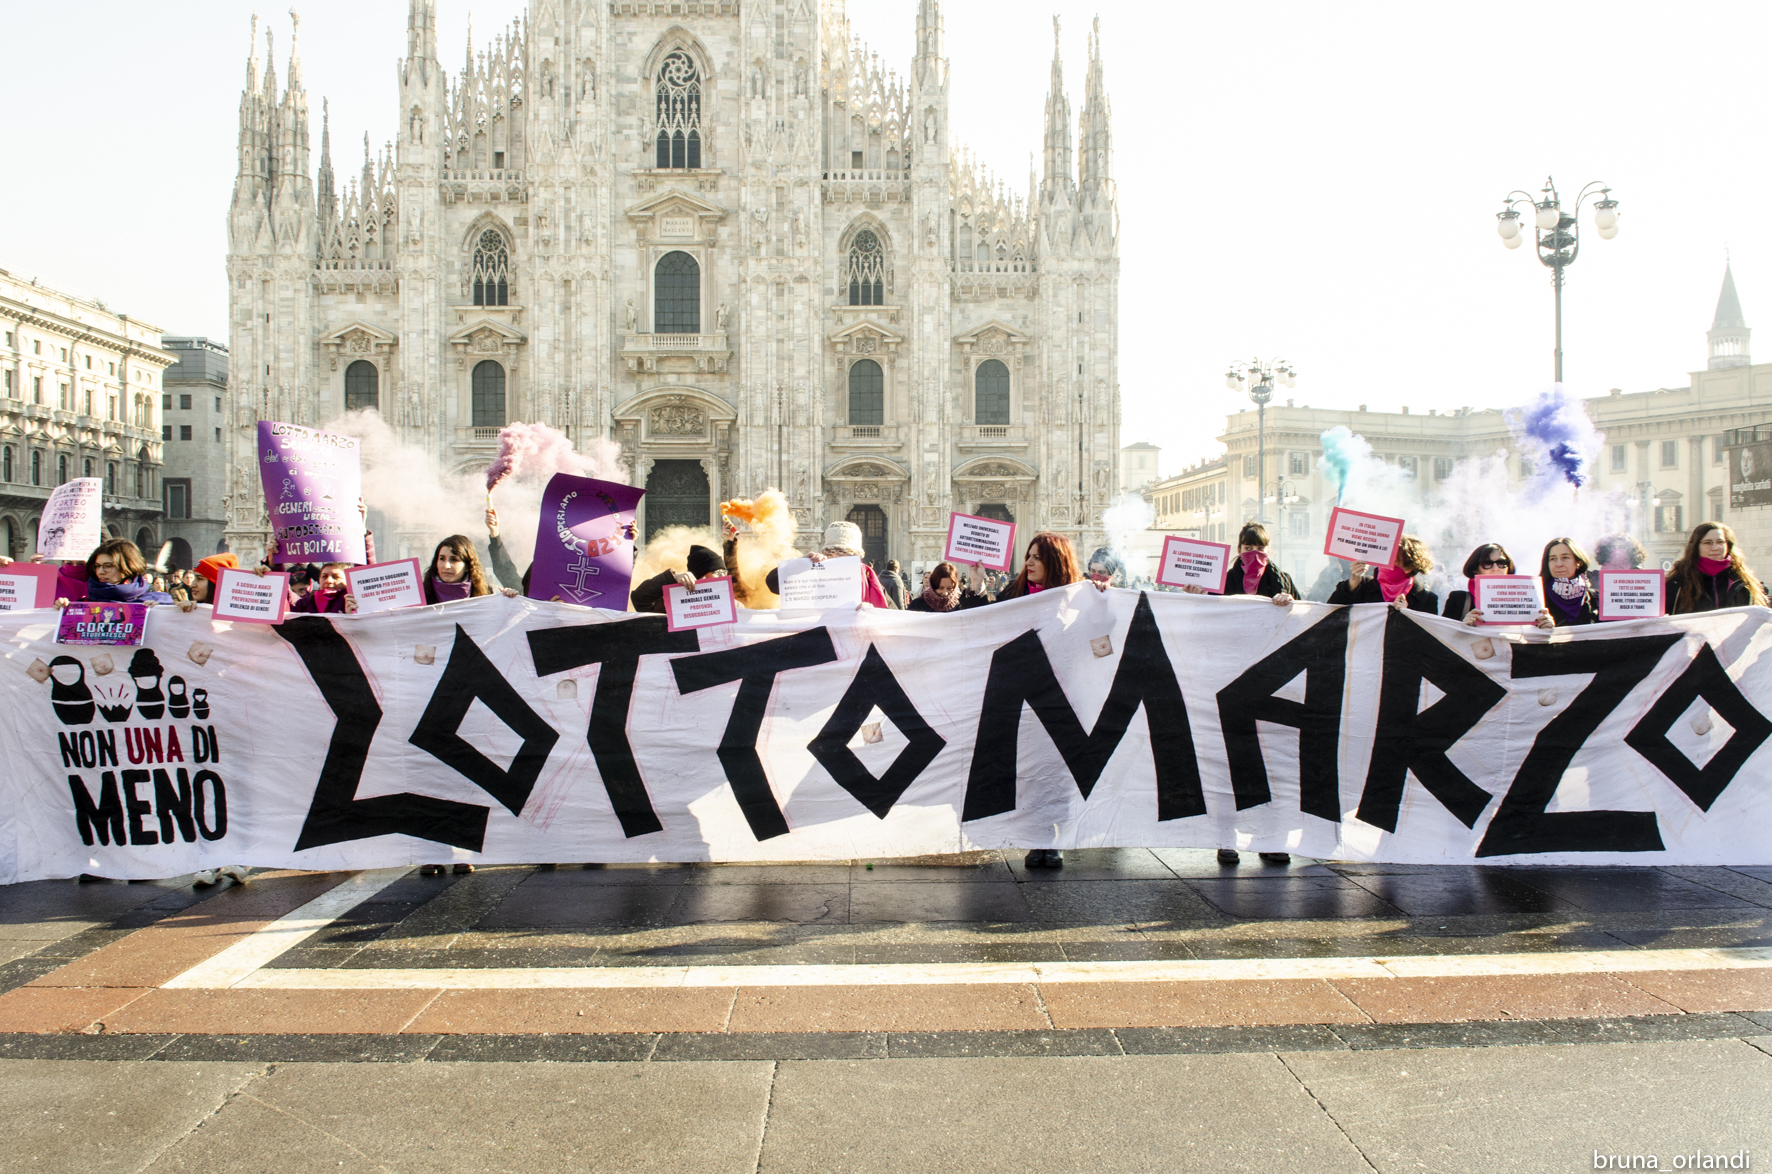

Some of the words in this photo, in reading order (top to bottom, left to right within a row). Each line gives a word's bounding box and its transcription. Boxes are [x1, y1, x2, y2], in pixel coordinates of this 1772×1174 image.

[271, 423, 308, 440] LOTTO
[312, 431, 354, 449] MARZO
[280, 438, 332, 457] SCIOPERO
[54, 500, 86, 508] CORTEO
[556, 490, 587, 556] SCIOPERIAMO
[76, 622, 134, 634] CORTEO
[271, 615, 947, 852] LOTTO
[962, 590, 1772, 857] MARZO
[58, 729, 118, 768] NON
[124, 725, 184, 764] UNA
[191, 725, 219, 764] DI
[68, 768, 228, 846] MENO
